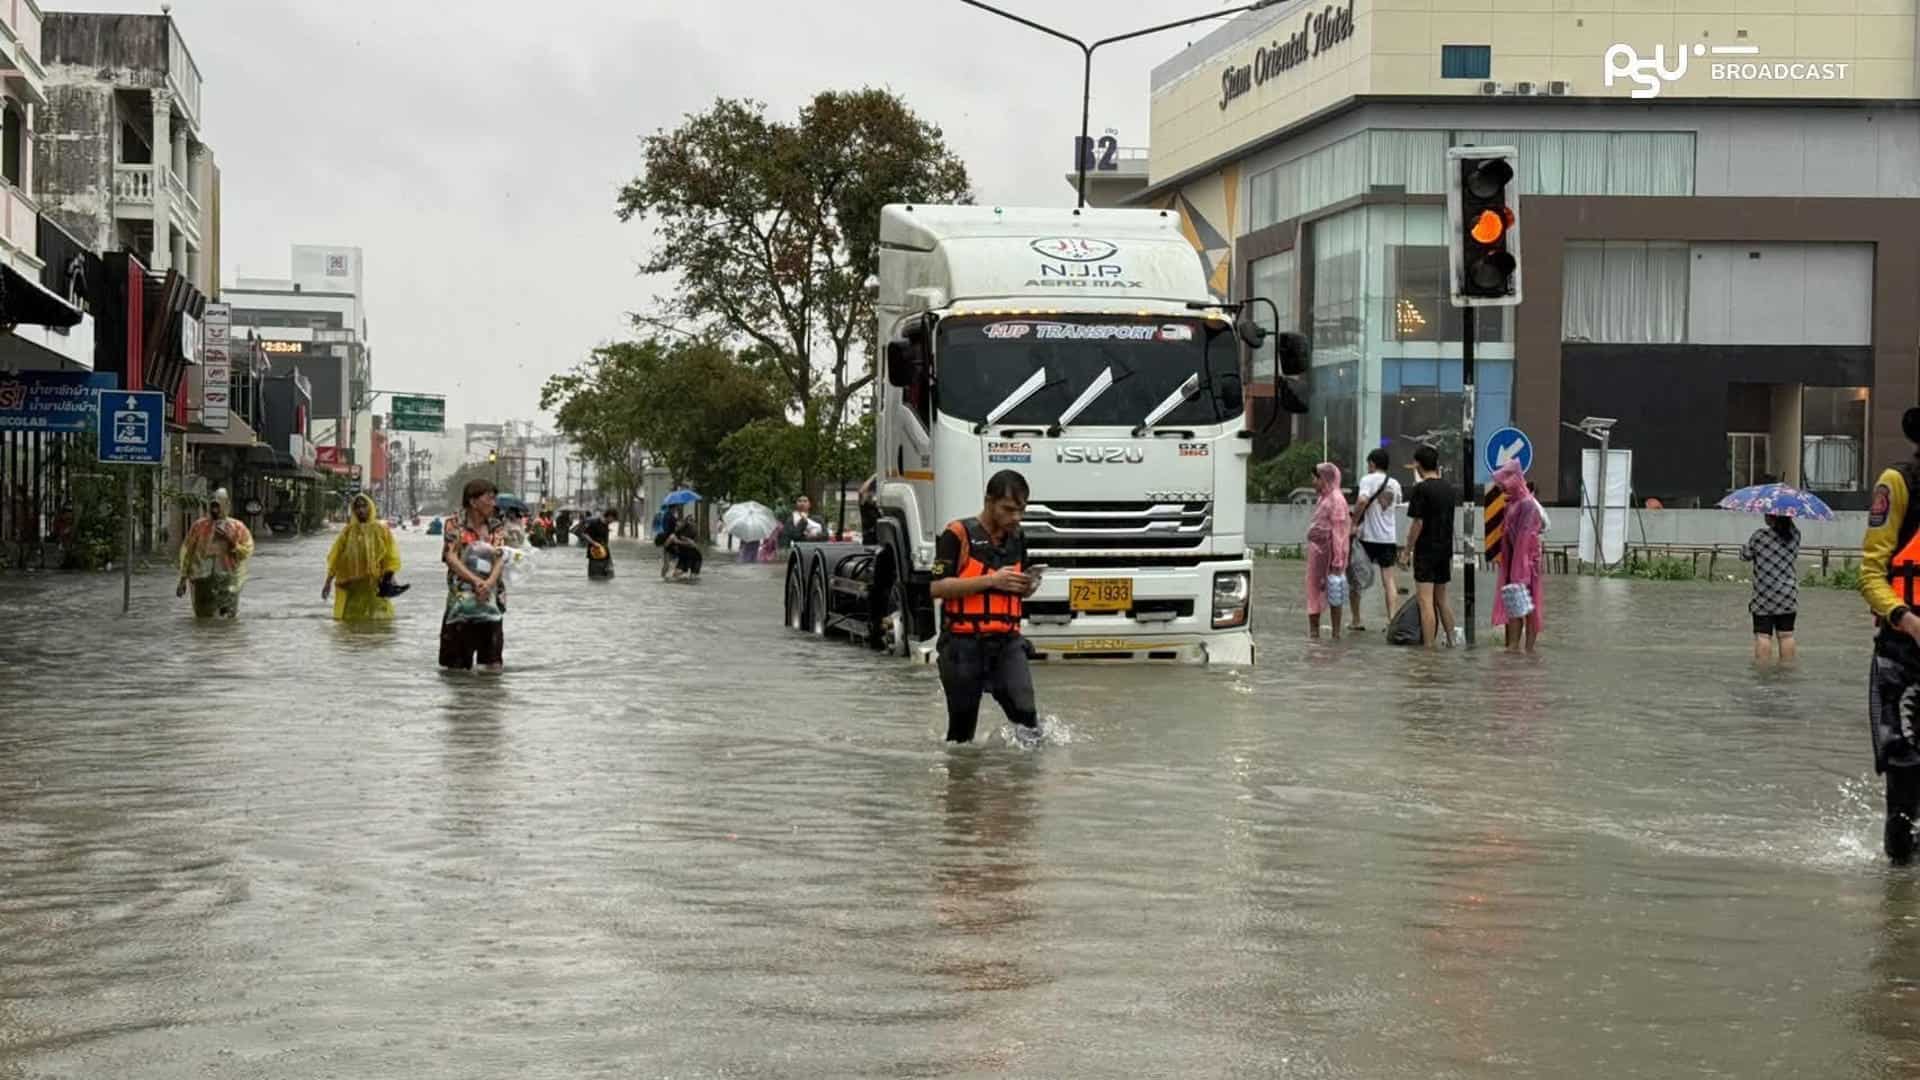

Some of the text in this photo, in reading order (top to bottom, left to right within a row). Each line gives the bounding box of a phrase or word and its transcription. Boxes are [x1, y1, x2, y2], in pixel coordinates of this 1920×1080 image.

[1219, 0, 1354, 111] Siam Oriental Hotel
[1075, 136, 1118, 170] B2
[1036, 324, 1157, 340] TRANSPORT
[1056, 446, 1144, 464] ISUZU
[1073, 585, 1128, 600] 72-1933
